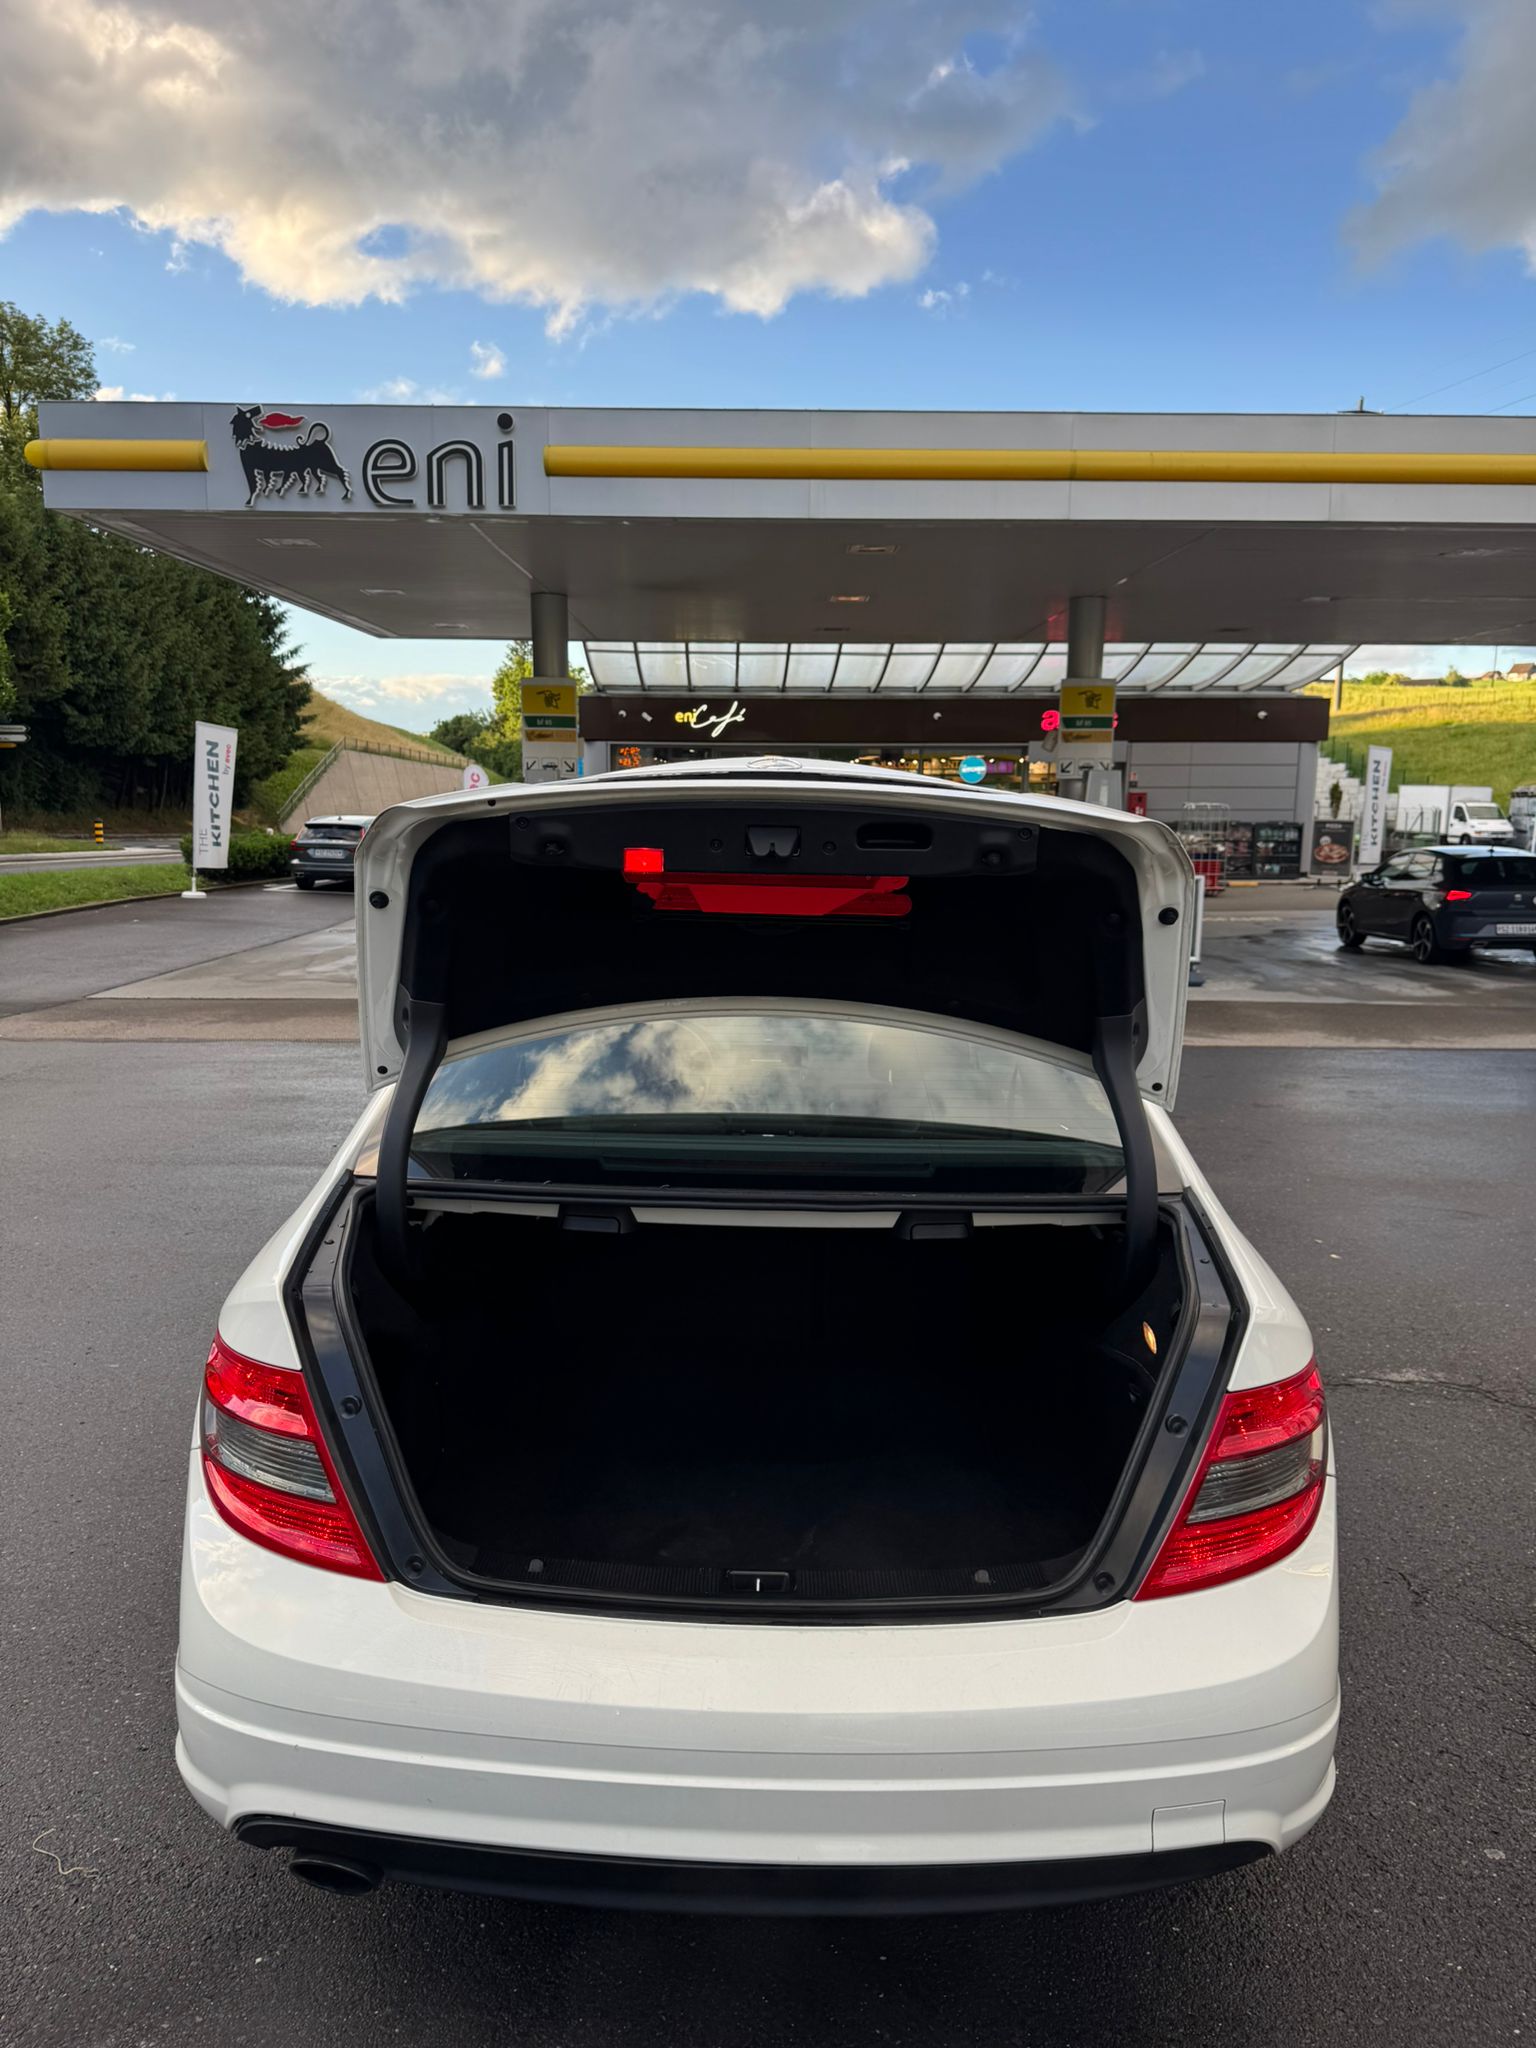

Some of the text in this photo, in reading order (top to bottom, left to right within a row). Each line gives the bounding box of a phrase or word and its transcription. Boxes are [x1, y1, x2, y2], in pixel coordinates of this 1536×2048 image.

[361, 412, 517, 507] eni
[206, 740, 221, 847] KITCHEN
[199, 828, 208, 855] THE
